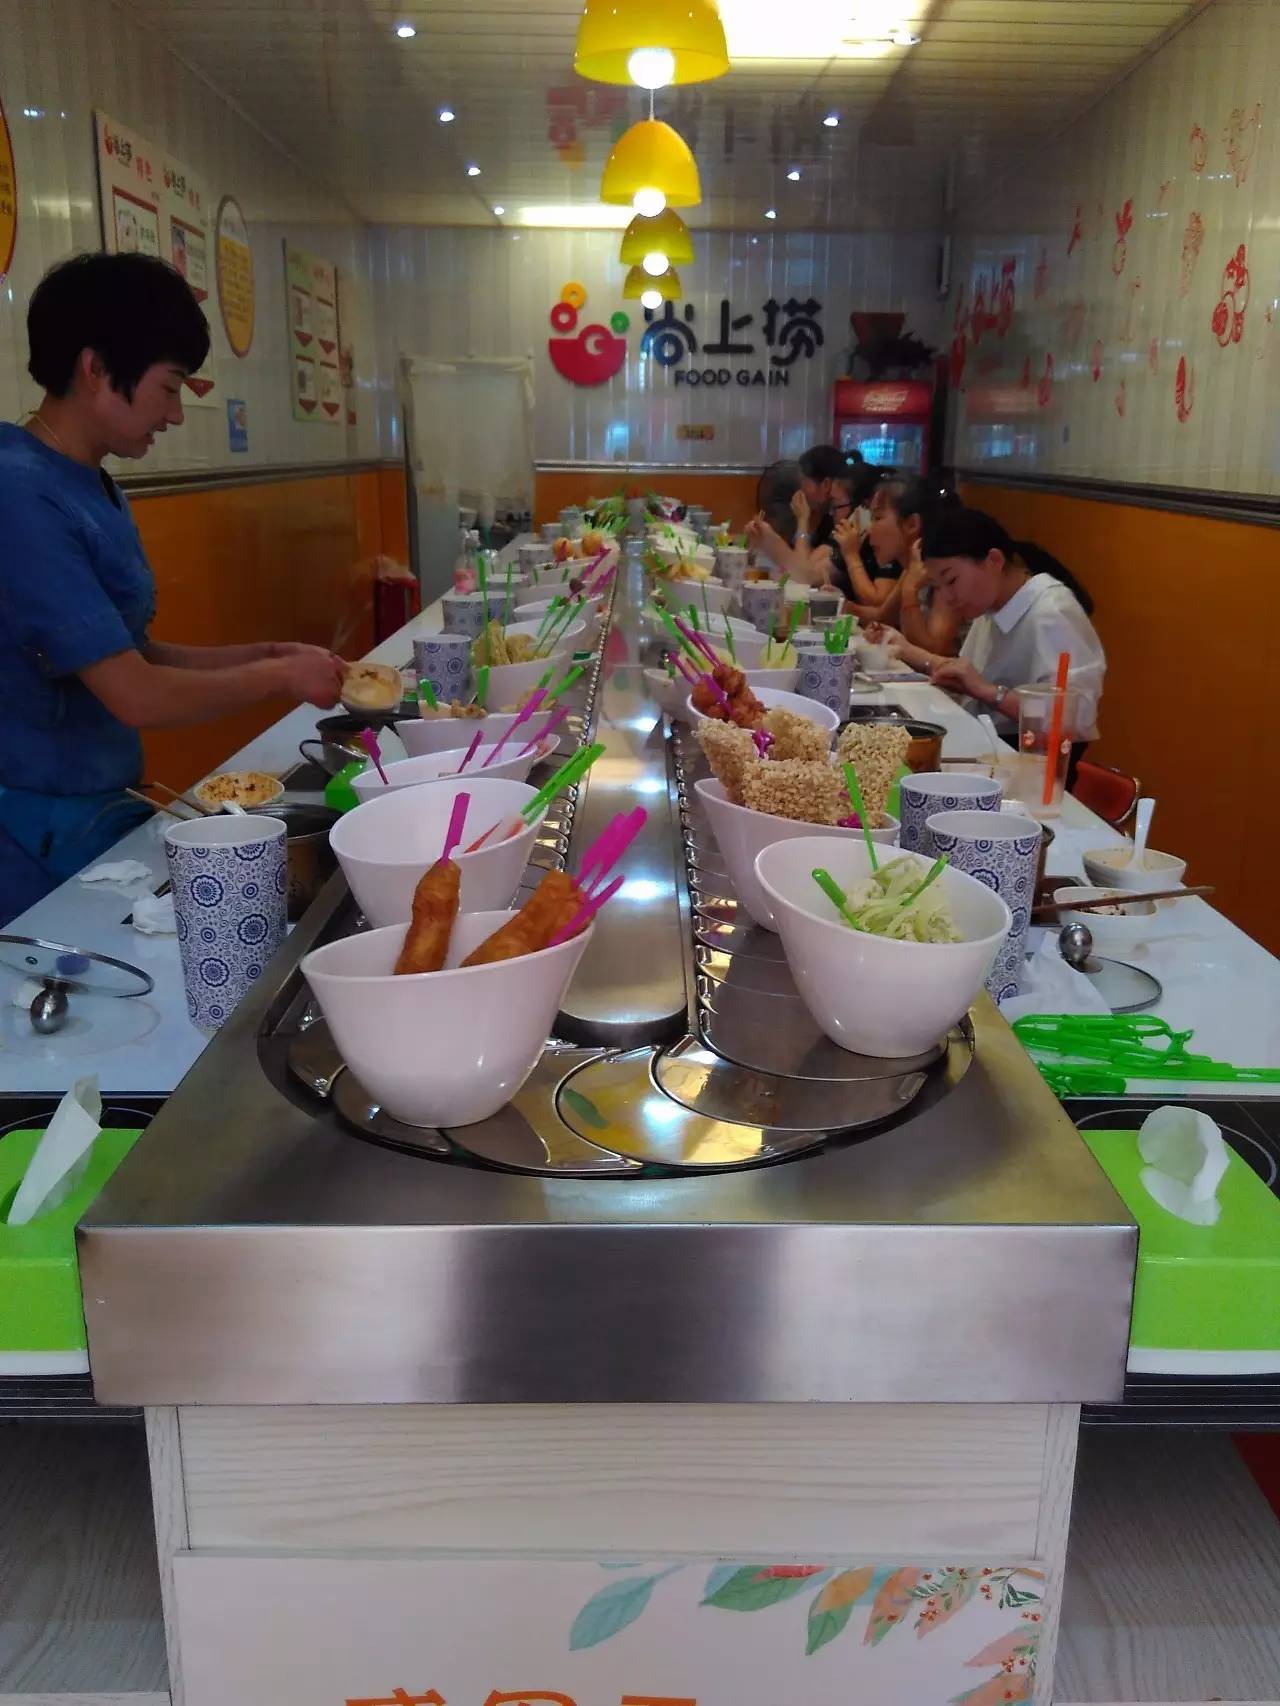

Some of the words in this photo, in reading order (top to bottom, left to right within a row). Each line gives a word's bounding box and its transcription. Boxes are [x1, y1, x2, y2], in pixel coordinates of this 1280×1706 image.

[640, 298, 826, 367] 尚上捞
[674, 369, 731, 387] FOOD
[736, 368, 789, 386] GAIN
